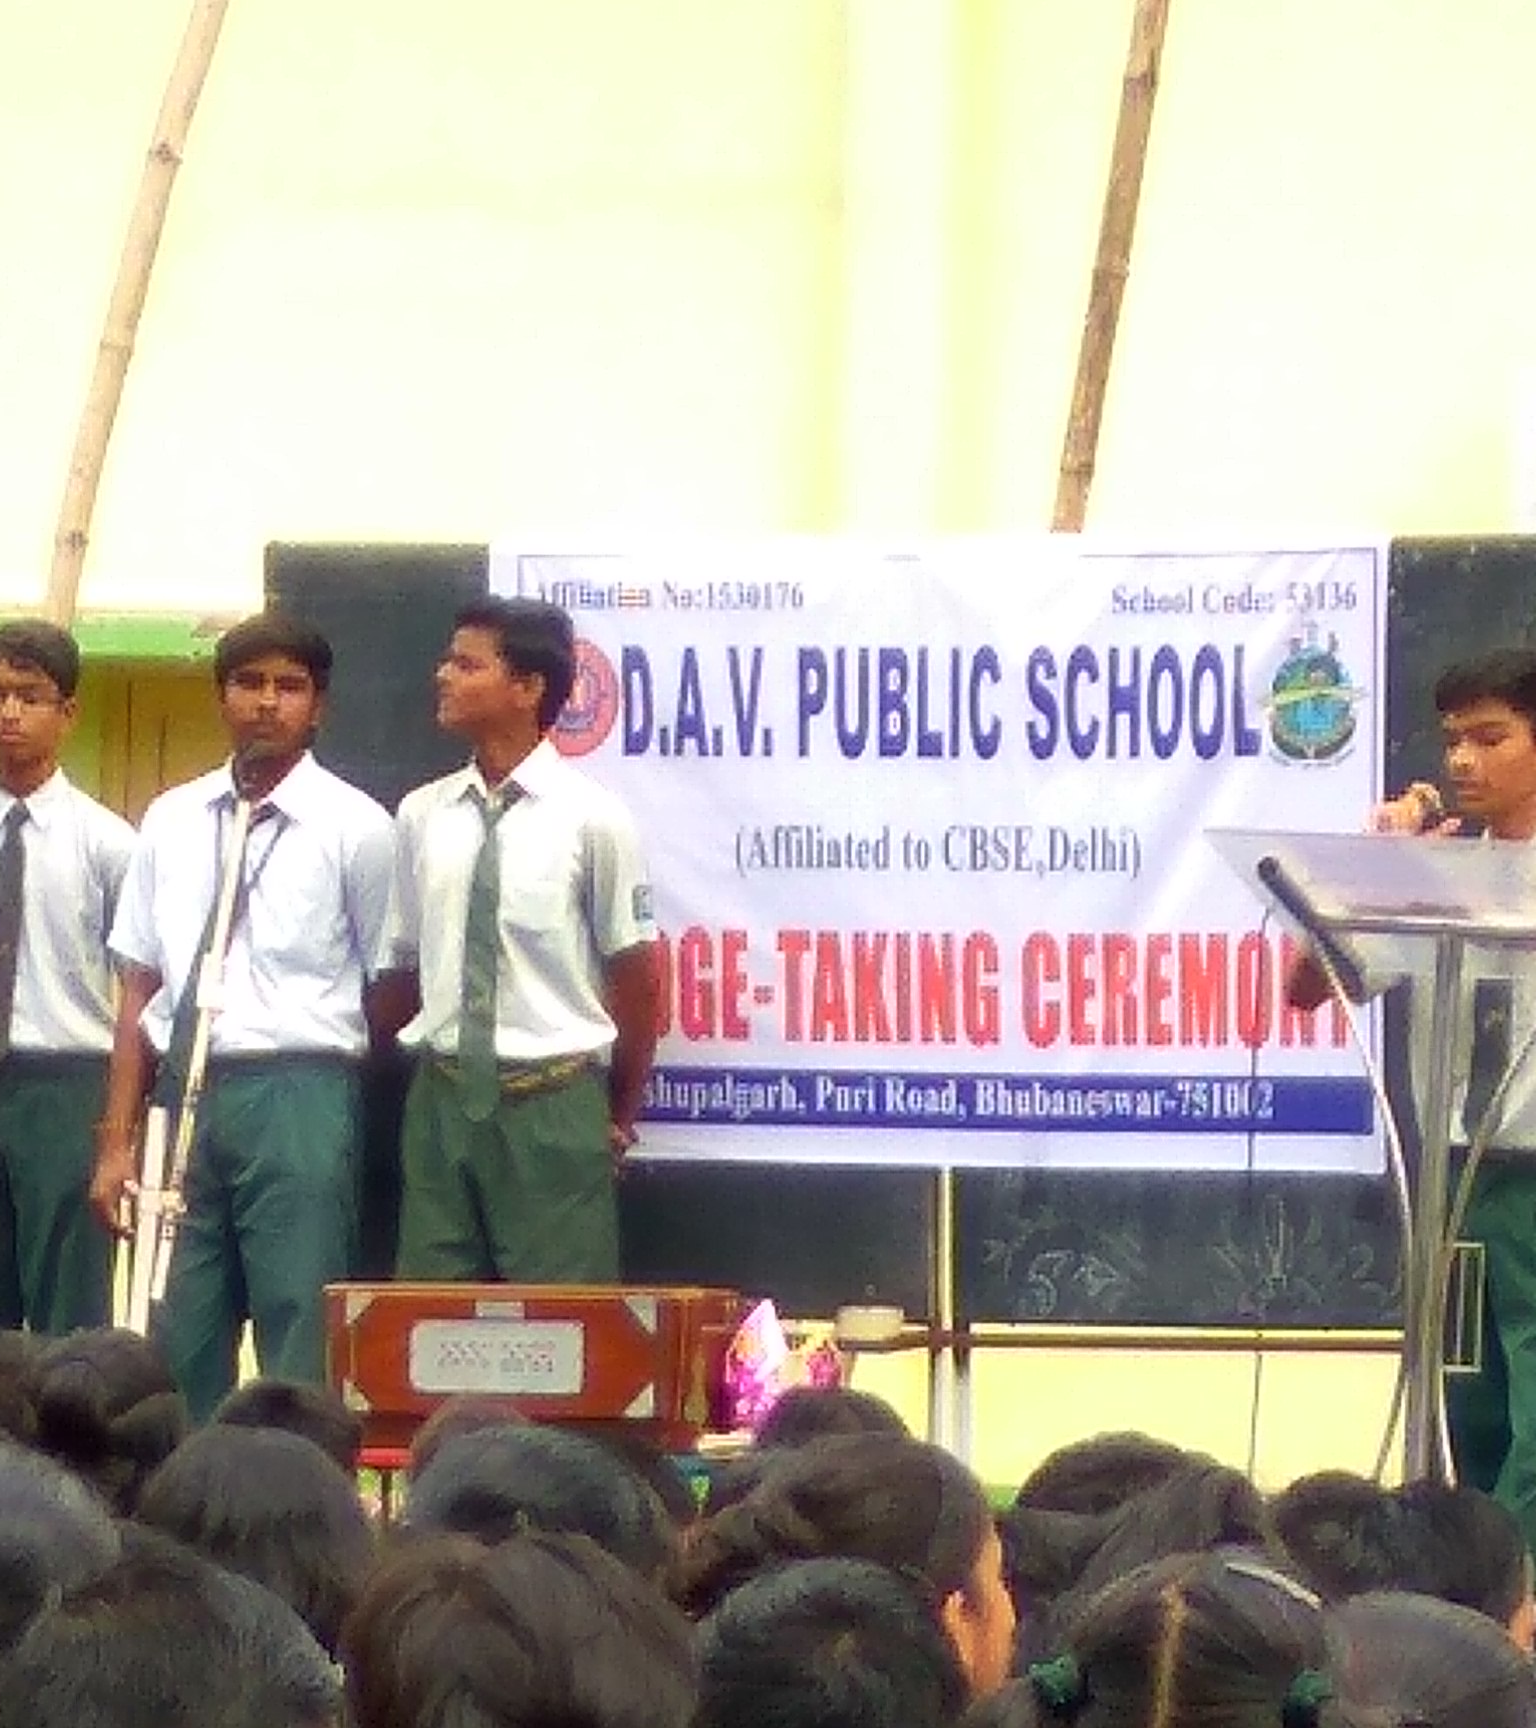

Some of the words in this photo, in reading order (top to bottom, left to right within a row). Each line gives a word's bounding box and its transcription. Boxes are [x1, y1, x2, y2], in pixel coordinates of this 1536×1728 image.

[1111, 583, 1194, 614] School
[1202, 583, 1275, 614] Code:
[620, 645, 772, 758] D.A.V.
[797, 645, 1001, 761] PUBLIC
[1025, 644, 1263, 761] SCHOOL
[735, 824, 891, 878] (Affiliated
[902, 825, 931, 872] to
[943, 824, 1142, 880] CBSE,Delhi)
[654, 926, 1000, 1047] GE-TAKING
[1021, 929, 1349, 1049] CEREMON
[815, 1075, 876, 1114] Puri
[884, 1077, 967, 1122] Road,
